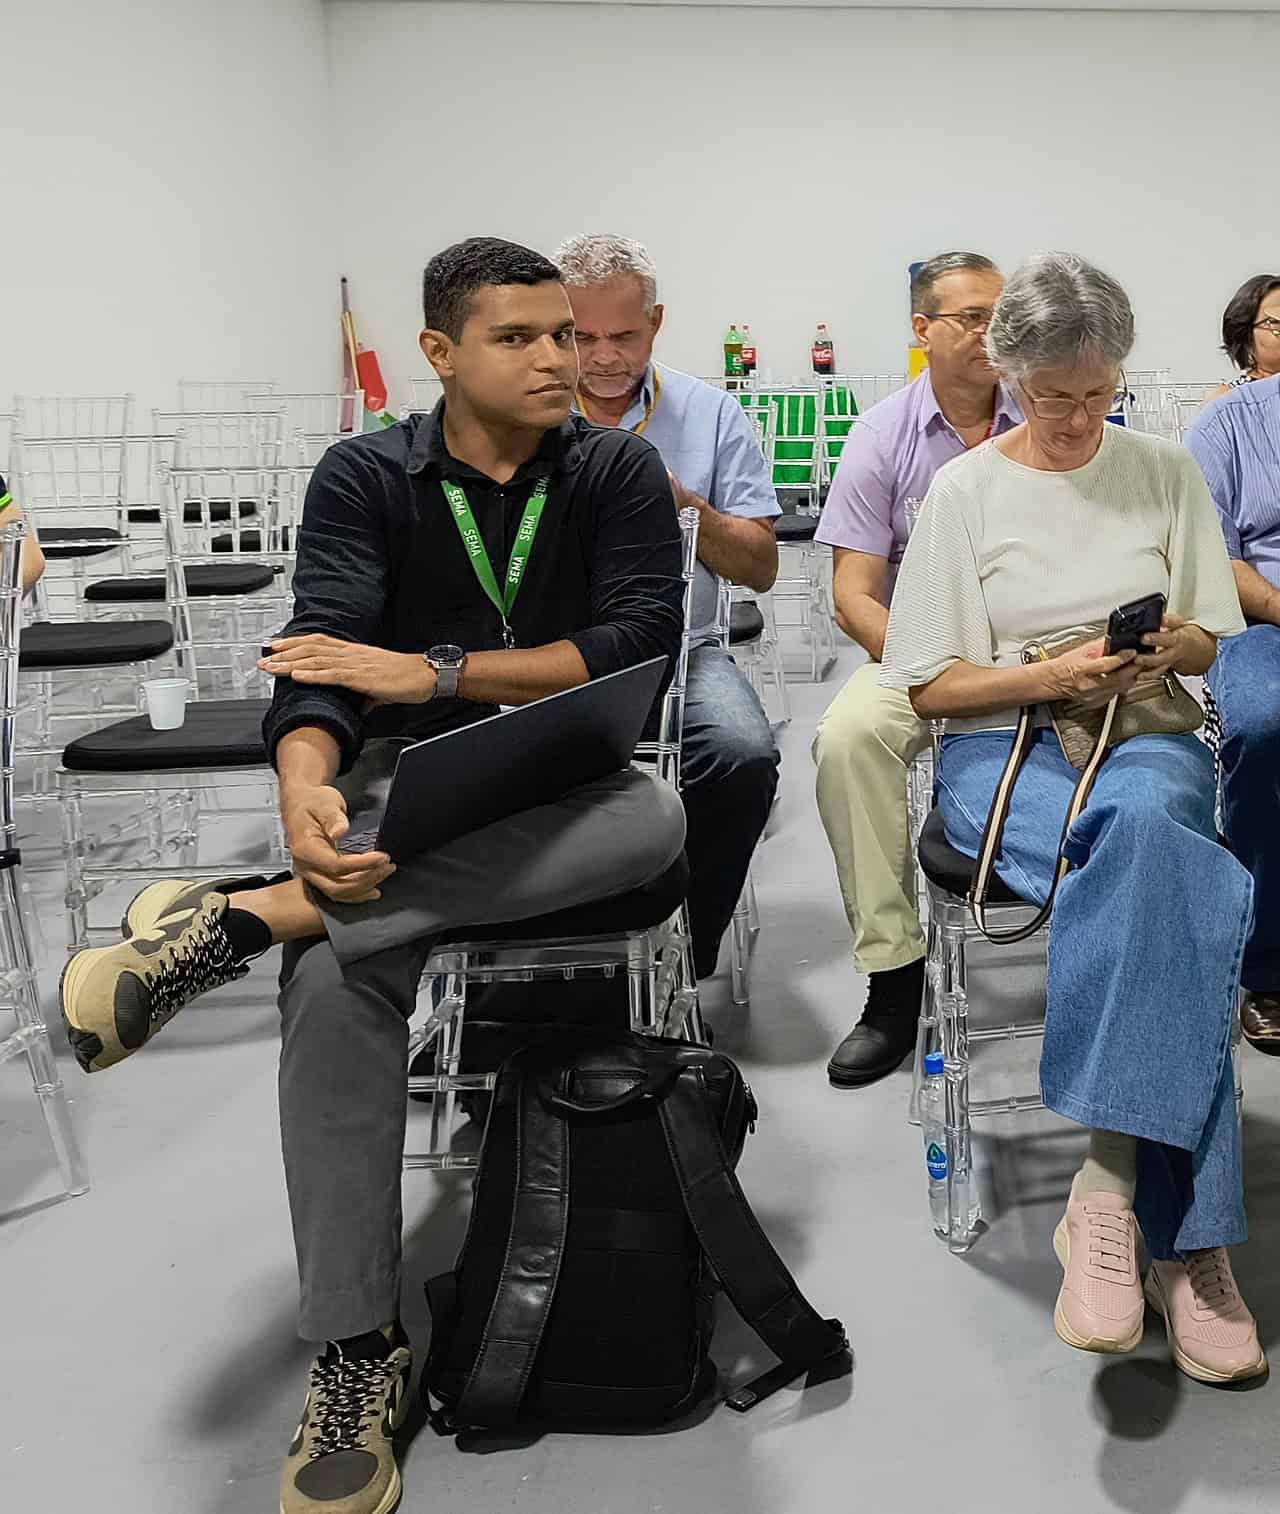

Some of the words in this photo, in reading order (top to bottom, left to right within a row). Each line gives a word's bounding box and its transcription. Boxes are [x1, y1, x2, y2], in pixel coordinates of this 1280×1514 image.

[449, 489, 467, 517] SEMA
[520, 514, 537, 541] SEMA
[464, 528, 482, 557] SEMA
[508, 556, 525, 584] SEMA
